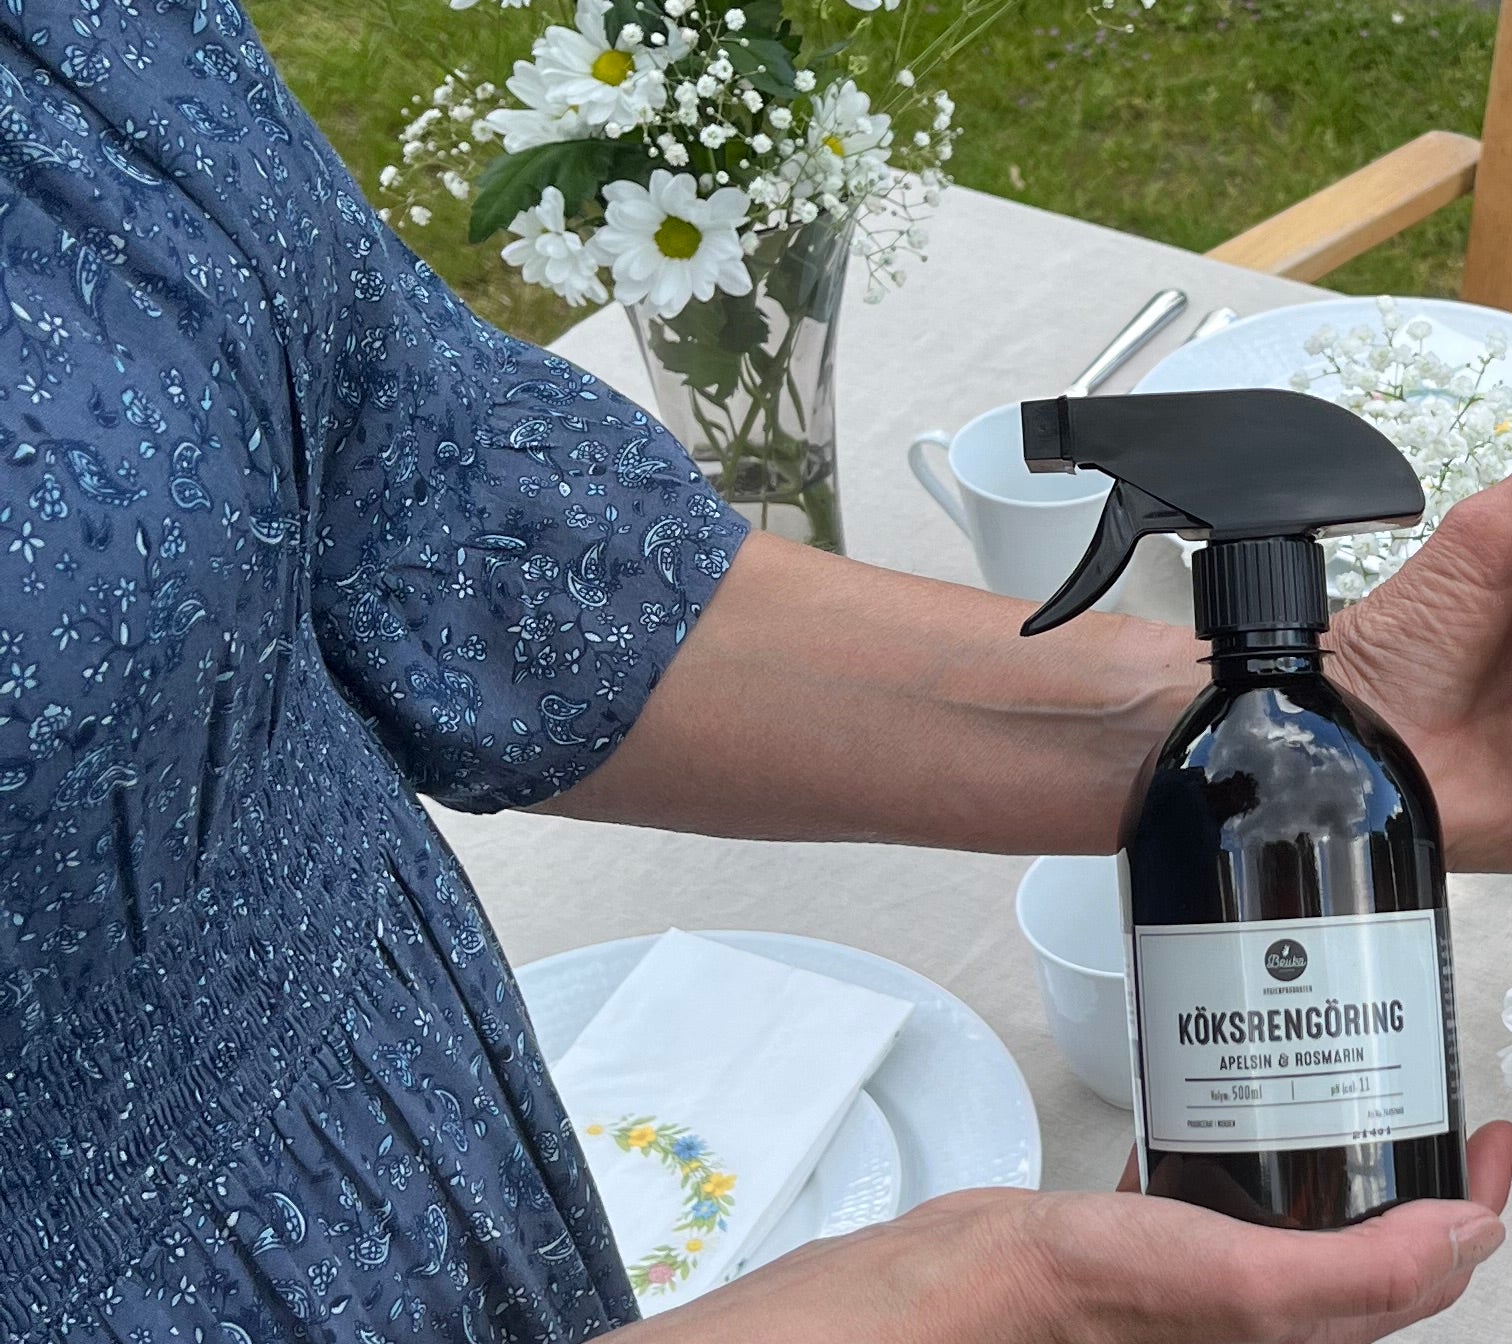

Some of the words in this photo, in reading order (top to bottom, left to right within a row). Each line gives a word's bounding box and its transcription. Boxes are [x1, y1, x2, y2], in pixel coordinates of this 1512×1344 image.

[1178, 998, 1405, 1046] KÖKSRENGÖRING
[1219, 1054, 1272, 1072] APELSIN
[1278, 1052, 1290, 1068] &
[1295, 1047, 1365, 1067] ROSMARIN
[1232, 1084, 1262, 1101] 500ml
[1359, 1076, 1370, 1092] 11
